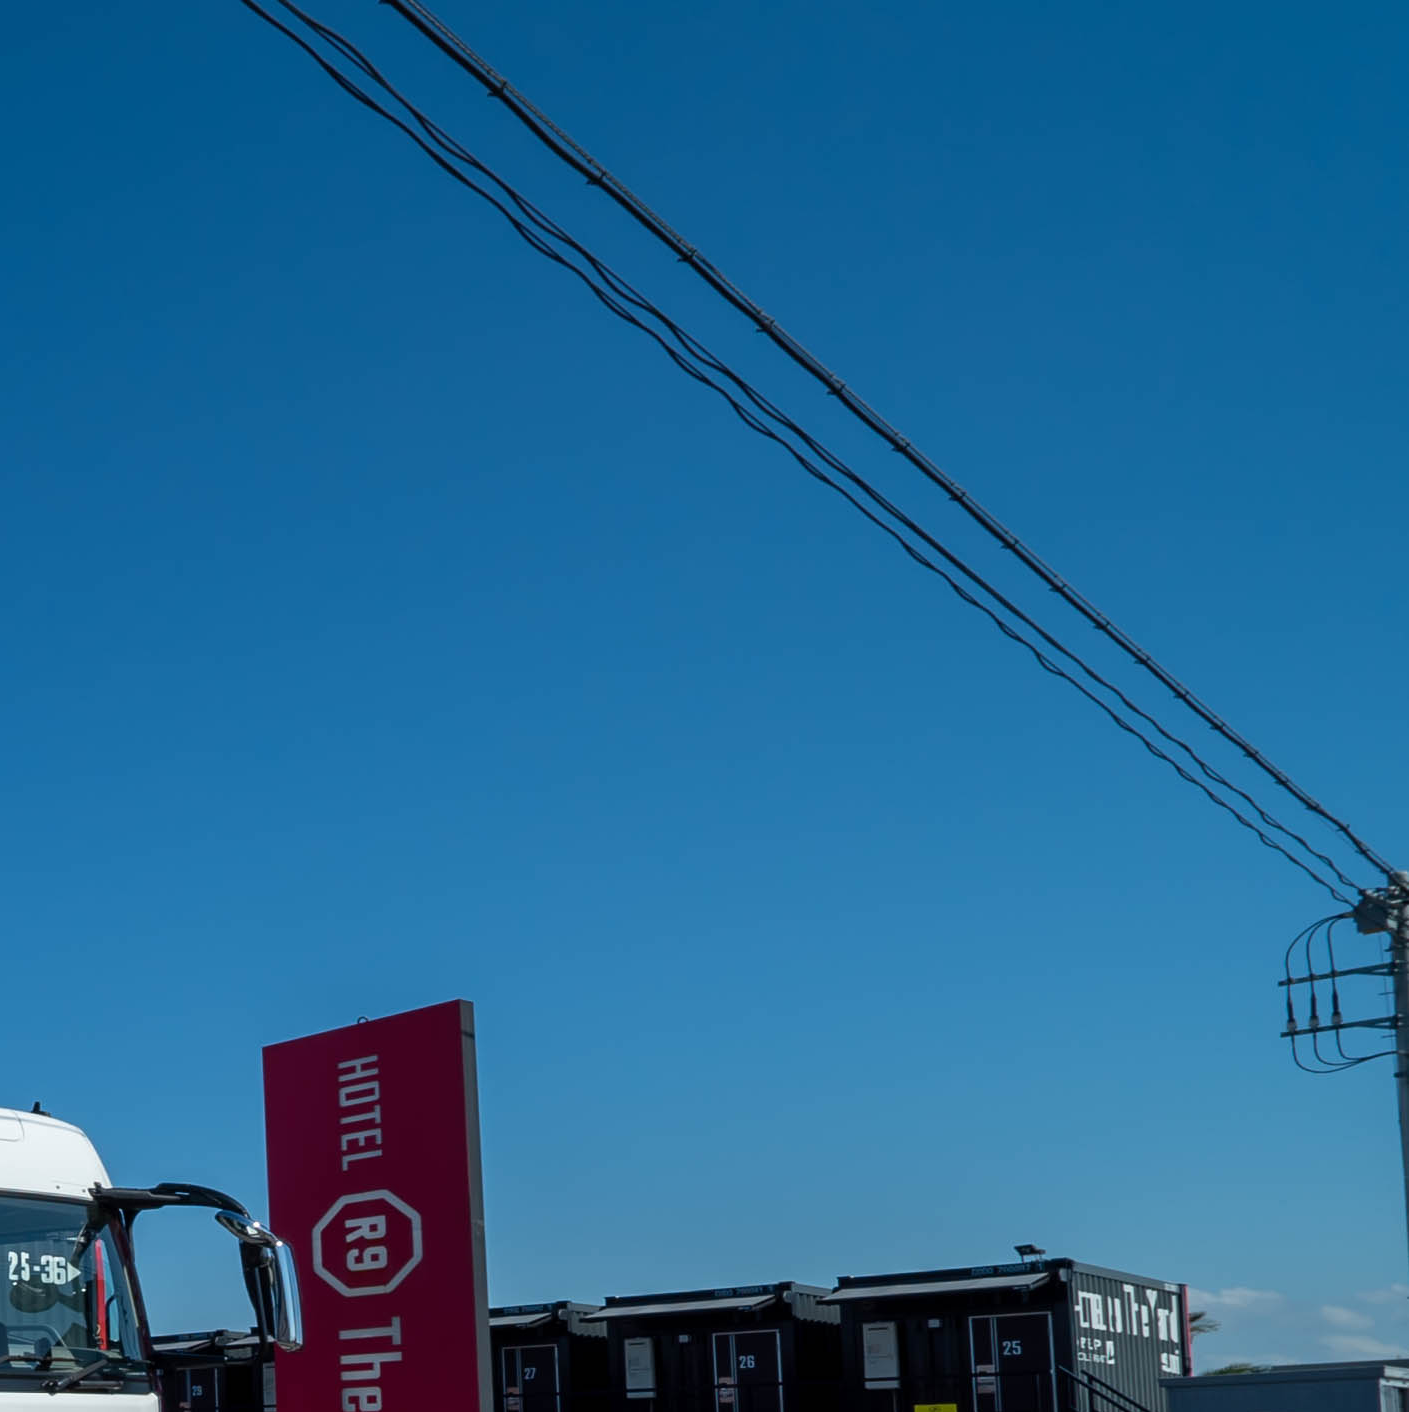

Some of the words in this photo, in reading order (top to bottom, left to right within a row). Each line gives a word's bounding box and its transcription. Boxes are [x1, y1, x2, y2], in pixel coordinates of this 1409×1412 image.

[337, 1054, 383, 1171] HOTEL
[344, 1215, 388, 1272] R9
[338, 1316, 403, 1412] The
[739, 1355, 755, 1368] 26
[1002, 1340, 1021, 1355] 25
[524, 1367, 536, 1380] 27
